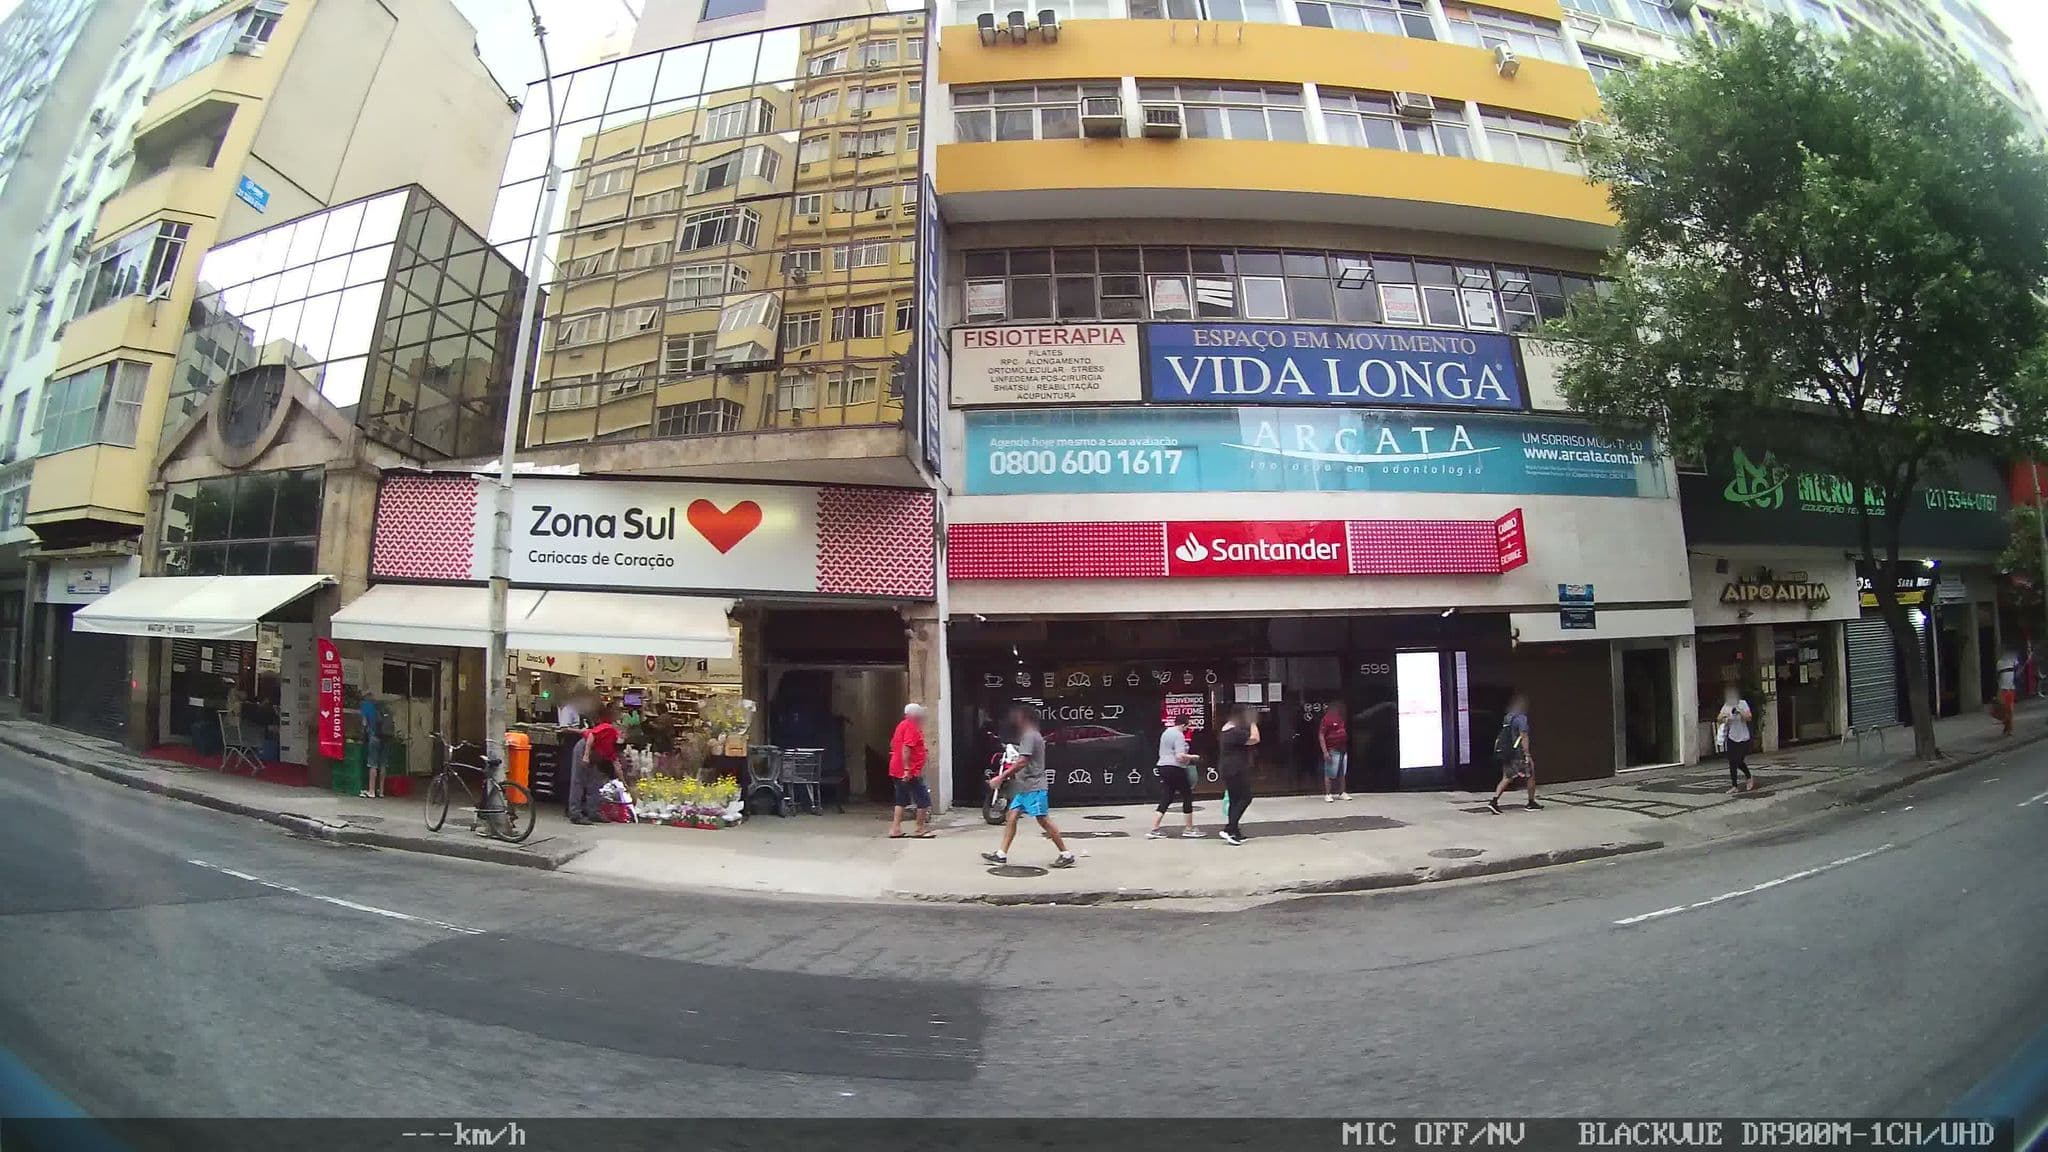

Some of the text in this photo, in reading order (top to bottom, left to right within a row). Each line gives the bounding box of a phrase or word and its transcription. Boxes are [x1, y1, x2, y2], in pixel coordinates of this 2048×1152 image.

[964, 328, 1125, 347] FISIOTERAPIA
[1193, 329, 1476, 355] ESPAÇO EM MOVIMENTO
[1026, 357, 1091, 365] ALONGAMENTO
[1164, 356, 1511, 400] VIDA LONGA
[1016, 392, 1076, 400] ACUPUNTURA
[989, 437, 1030, 449] Agende
[1031, 437, 1055, 449] hoje
[1056, 438, 1098, 446] mesmo
[1129, 436, 1178, 448] avaliação
[1254, 421, 1475, 455] ARCATA
[1522, 432, 1540, 444] UM
[1541, 433, 1586, 447] SORRISO
[990, 450, 1183, 475] 0800 600 1617
[1523, 446, 1645, 464] www.arcata.com.br
[1346, 464, 1364, 473] em
[1382, 464, 1482, 477] odontologia
[529, 505, 675, 540] Zona Sul
[1211, 538, 1341, 562] Santander
[528, 550, 674, 570] Cariocas de Coração
[1360, 663, 1390, 675] 599
[1060, 706, 1094, 720] Café
